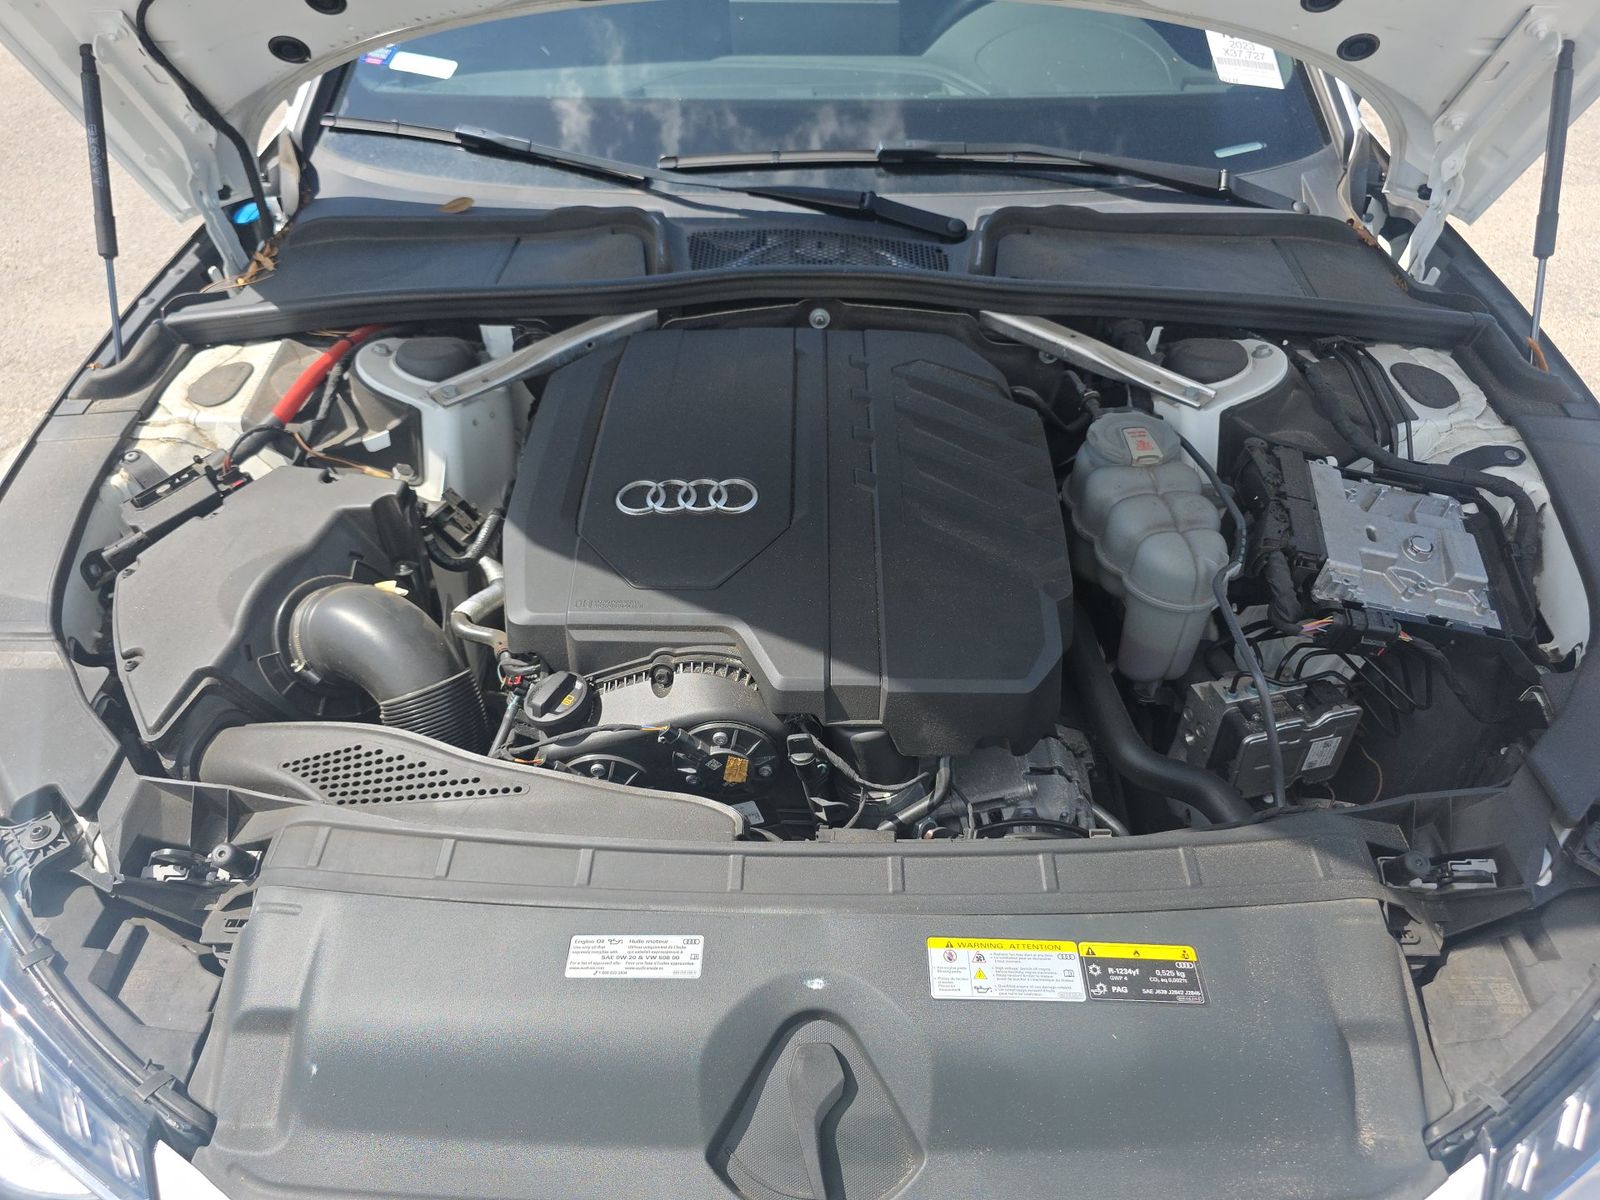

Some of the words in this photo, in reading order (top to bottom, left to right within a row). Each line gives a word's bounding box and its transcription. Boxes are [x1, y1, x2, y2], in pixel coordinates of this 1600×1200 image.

[1228, 40, 1256, 51] 2023
[1009, 943, 1062, 951] ATTENTION
[1107, 967, 1140, 976] R-1234yf
[1176, 970, 1186, 978] kg
[1111, 986, 1129, 994] PAG
